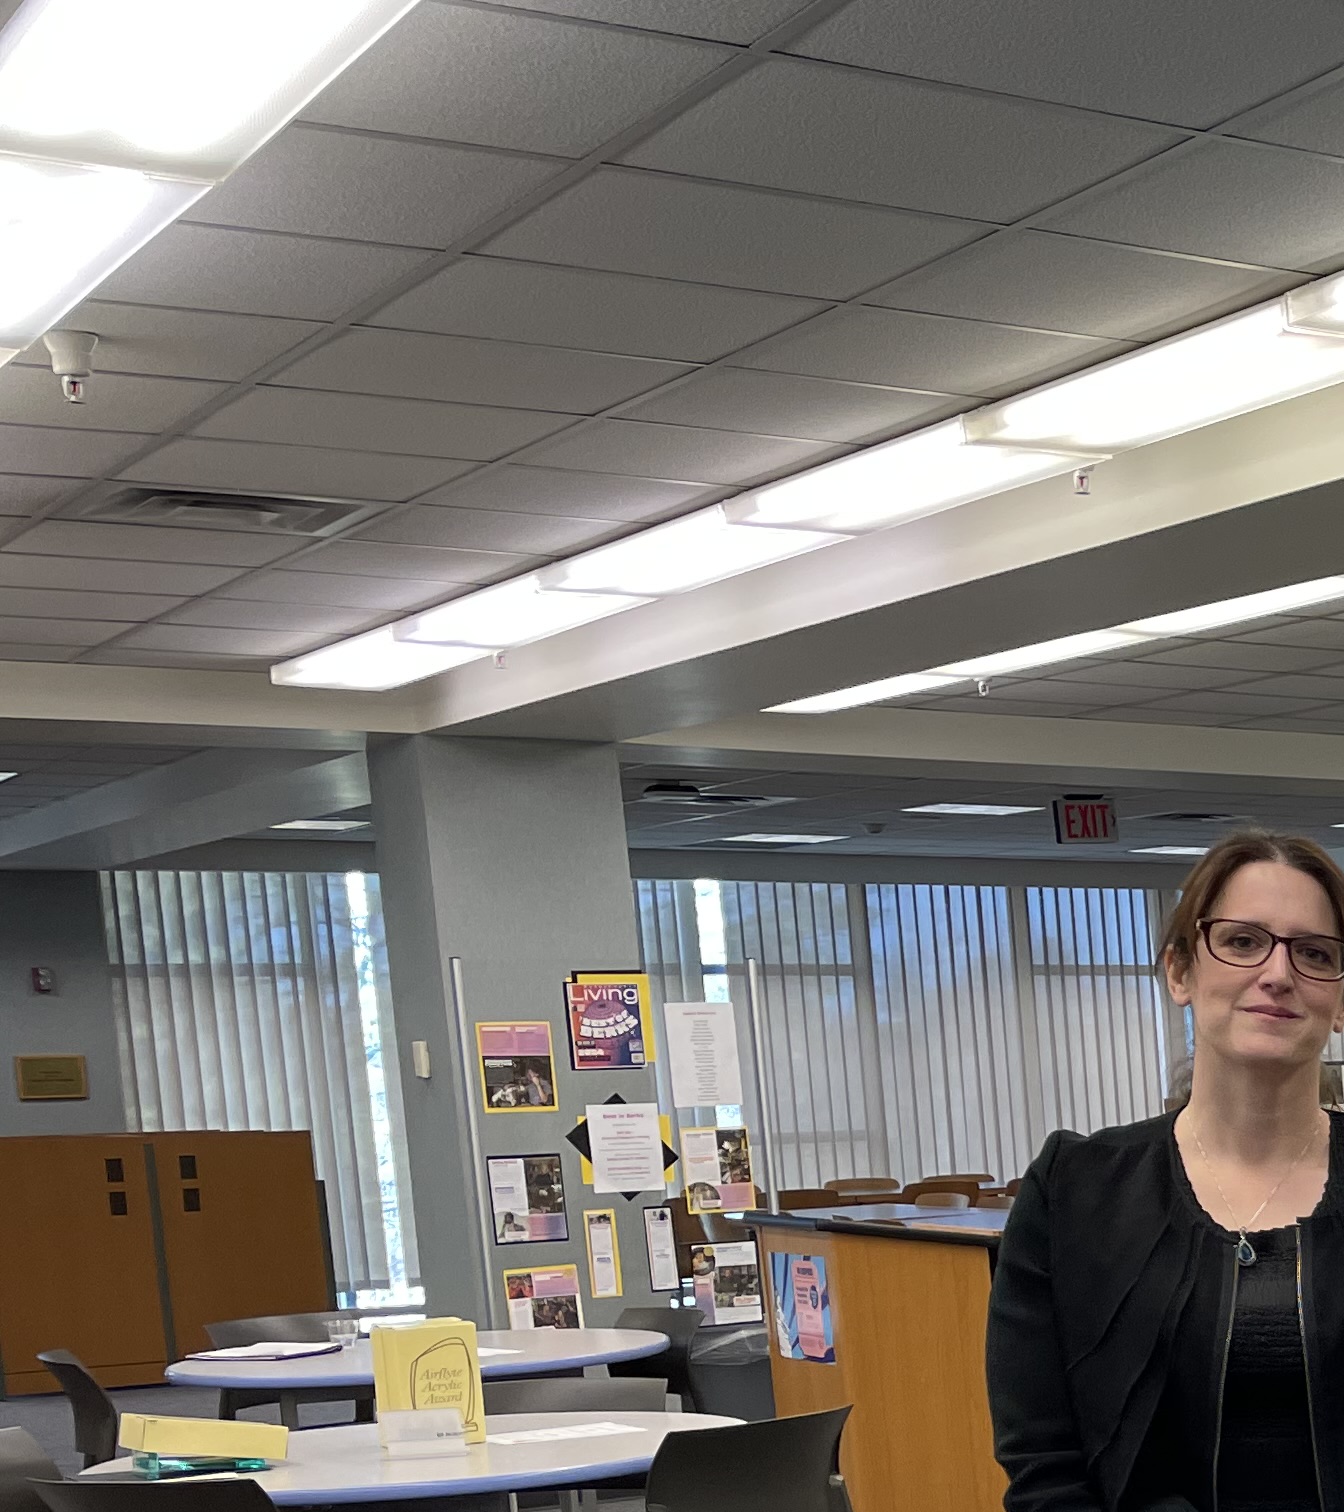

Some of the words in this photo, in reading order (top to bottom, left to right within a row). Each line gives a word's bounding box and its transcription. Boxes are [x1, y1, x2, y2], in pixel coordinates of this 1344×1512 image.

[1064, 804, 1108, 838] EXIT
[570, 988, 638, 1005] Living
[419, 1367, 462, 1381] Airflyte
[421, 1380, 462, 1393] Acrylic
[423, 1391, 463, 1405] Award
